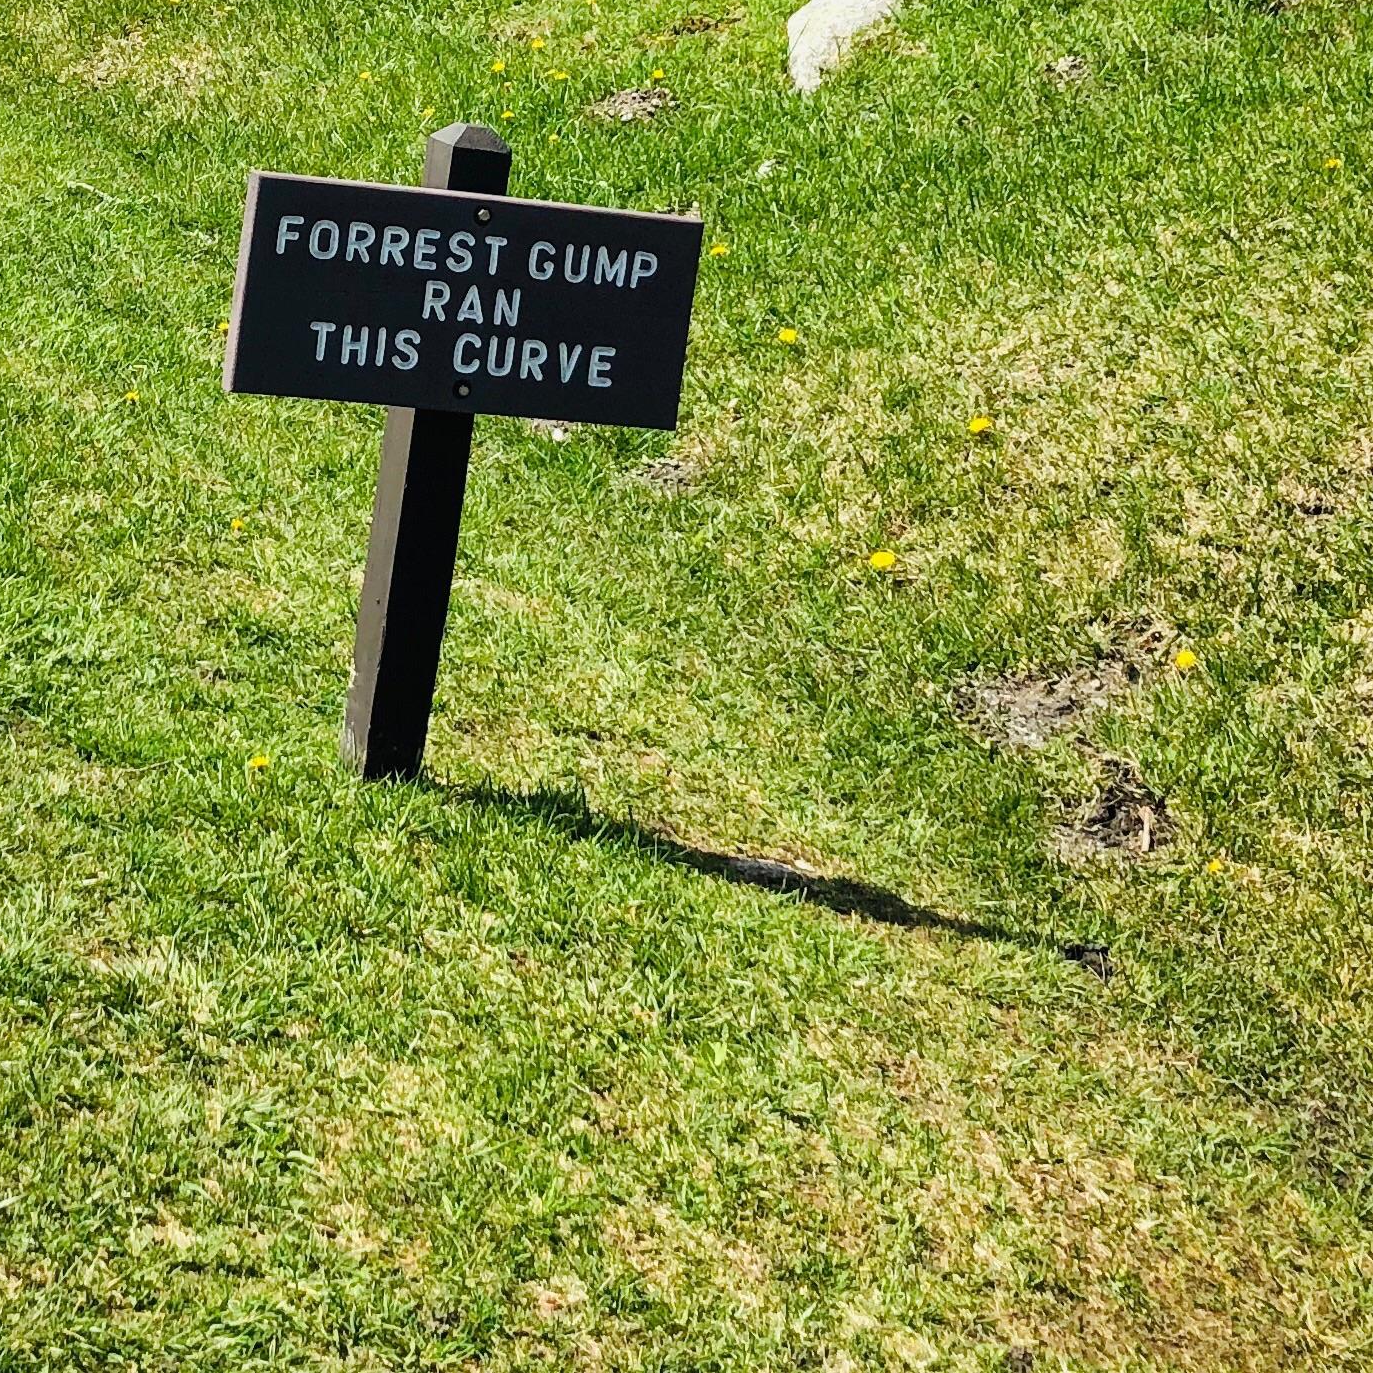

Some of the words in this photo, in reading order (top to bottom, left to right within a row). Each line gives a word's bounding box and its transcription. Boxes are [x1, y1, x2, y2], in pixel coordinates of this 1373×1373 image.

[275, 215, 508, 276] FORREST
[528, 241, 658, 289] GUMP
[421, 280, 521, 327] RAN
[309, 321, 421, 370] THIS
[453, 332, 617, 388] CURVE
